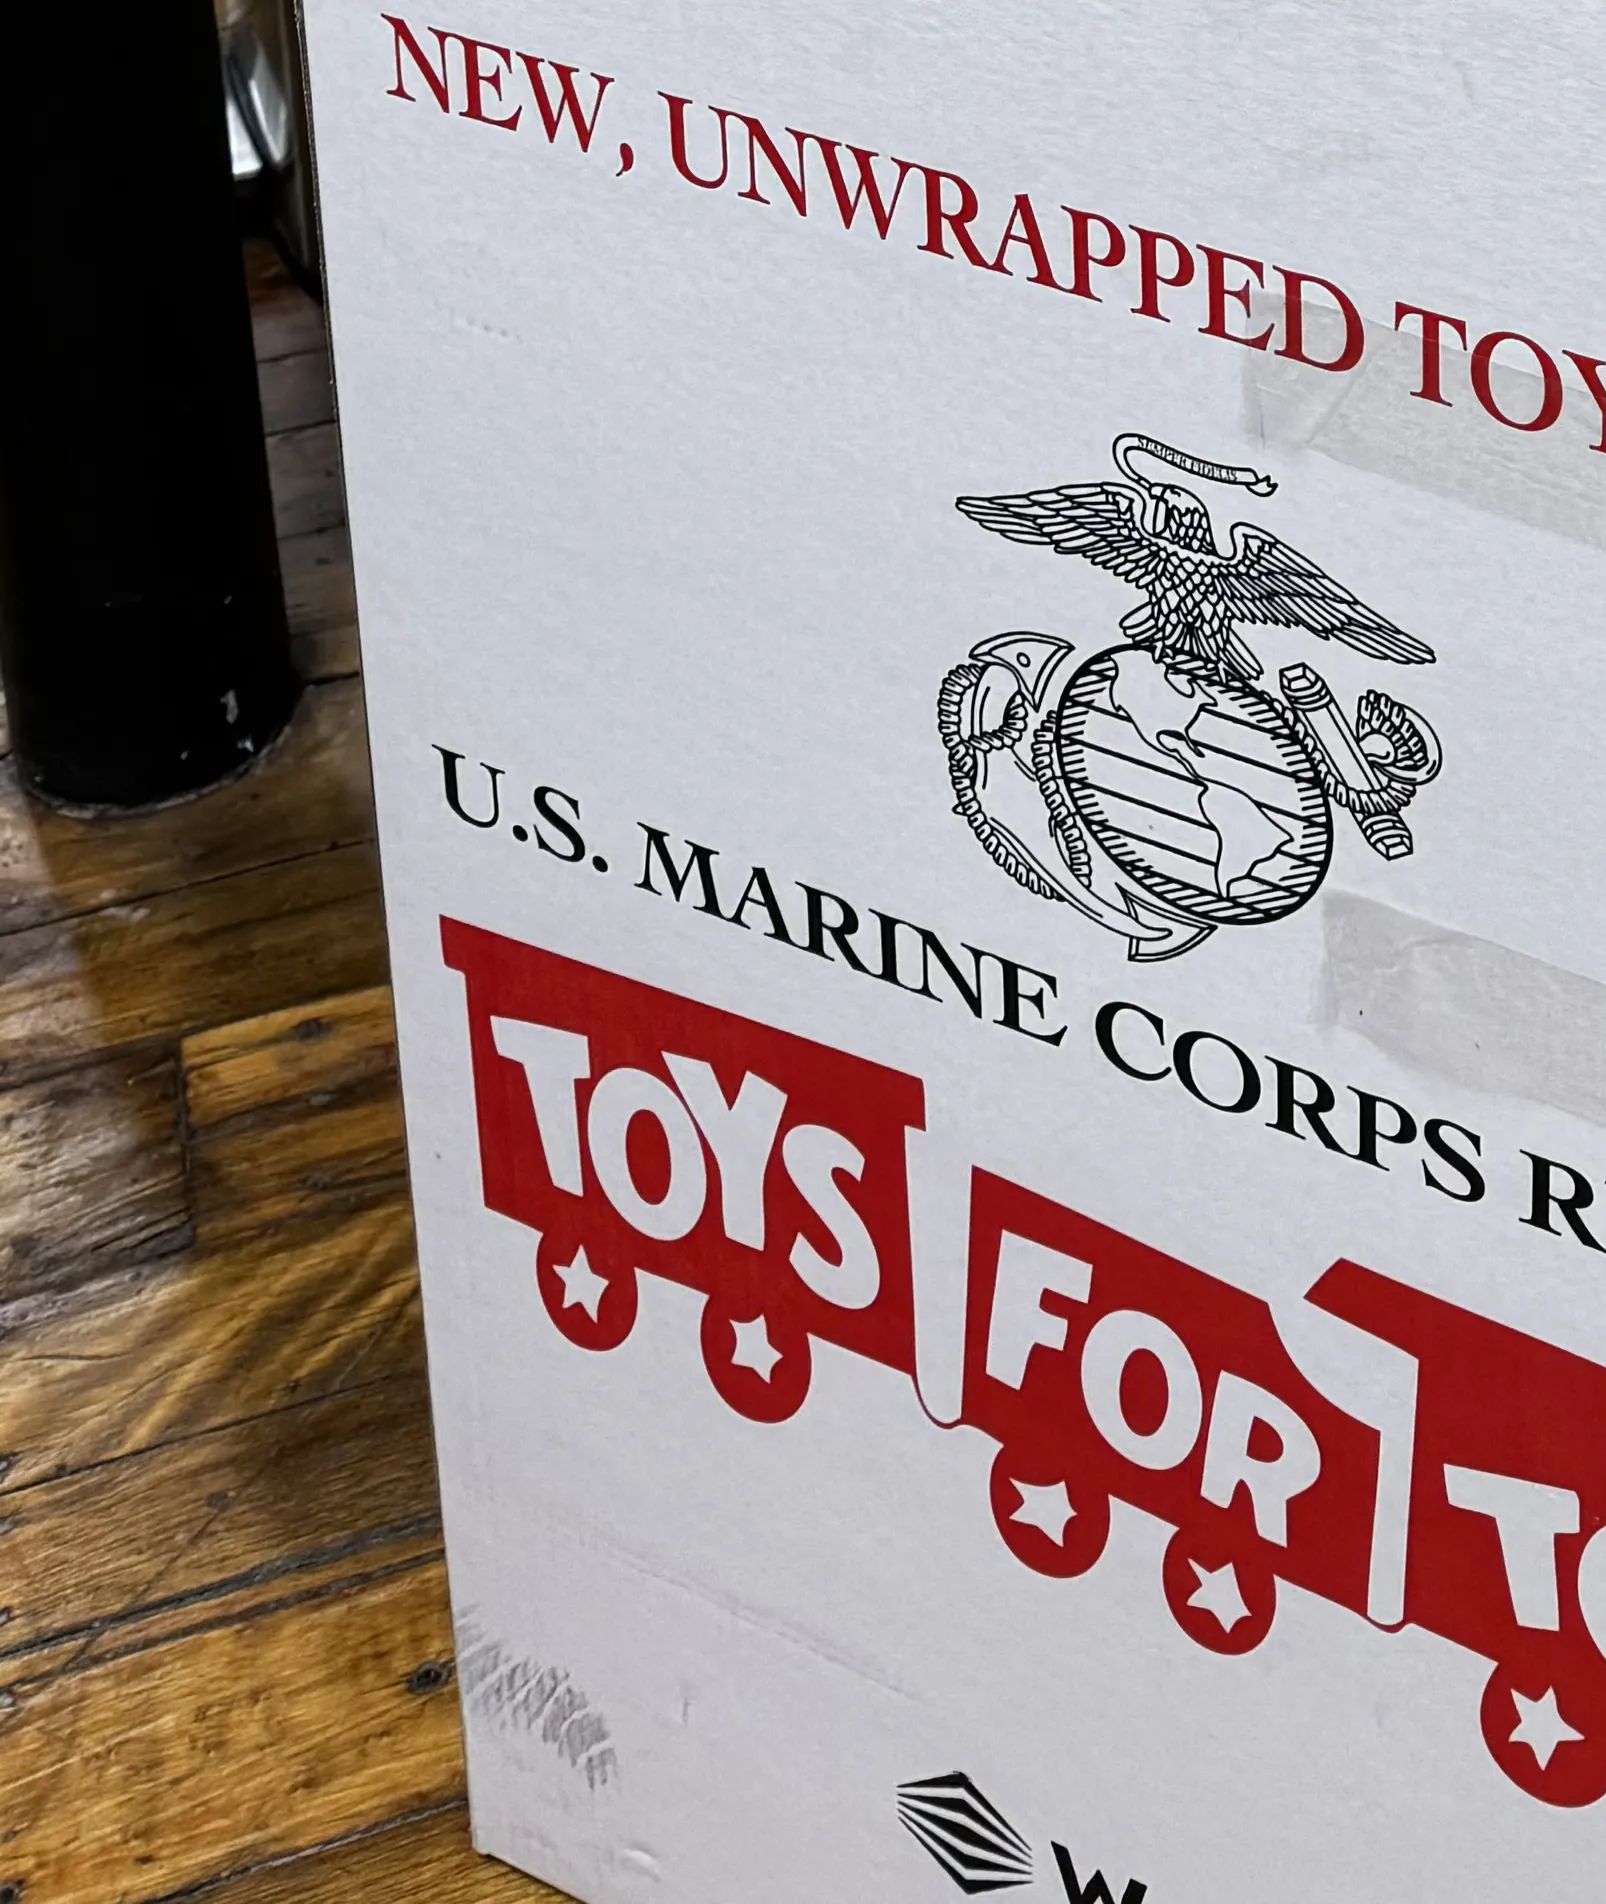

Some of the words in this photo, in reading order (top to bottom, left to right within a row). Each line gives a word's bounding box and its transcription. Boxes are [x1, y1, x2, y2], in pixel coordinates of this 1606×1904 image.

[386, 15, 634, 173] NEW,
[665, 95, 1365, 372] UNWRAPPED
[432, 744, 609, 873] U.S.
[634, 822, 1069, 1047] MARINE
[1094, 1001, 1487, 1204] CORPS
[491, 1015, 880, 1309] TOYS
[986, 1230, 1323, 1534] FOR
